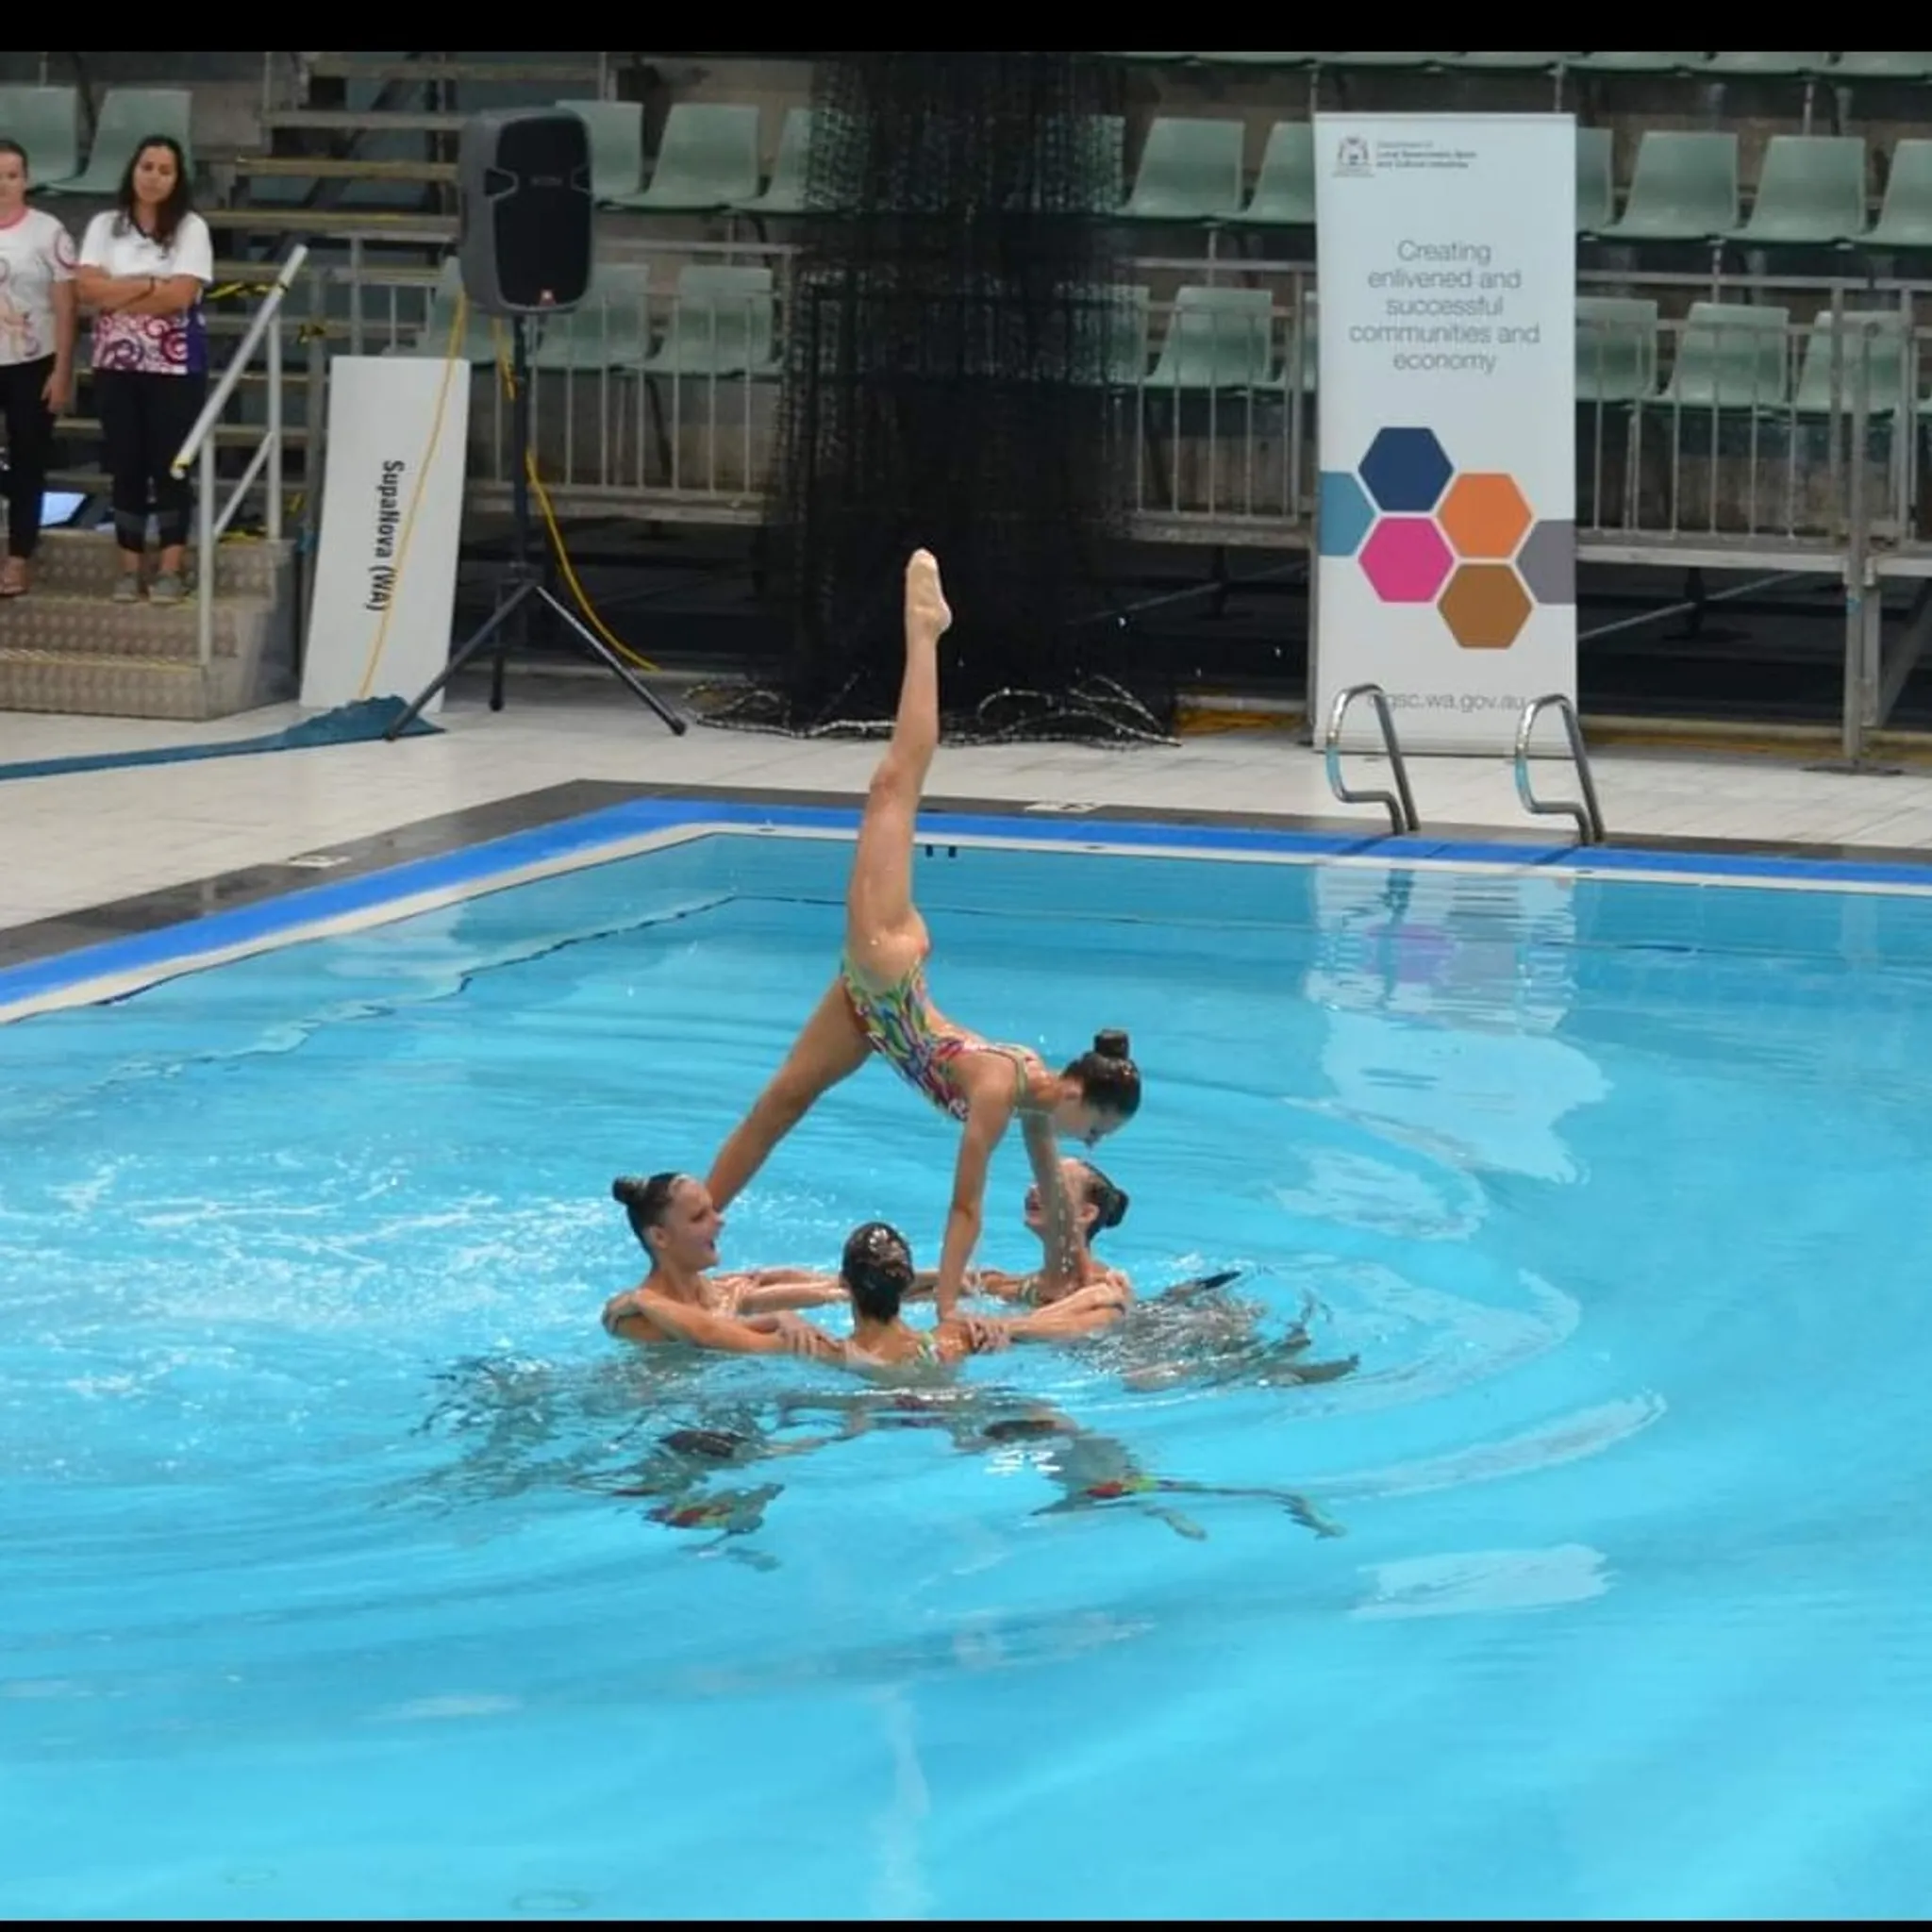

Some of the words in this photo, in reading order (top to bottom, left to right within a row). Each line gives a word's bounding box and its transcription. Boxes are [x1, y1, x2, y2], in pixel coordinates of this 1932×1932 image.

[1397, 240, 1491, 265] Creating
[1368, 269, 1472, 290] enlivened
[1479, 268, 1522, 290] and
[1386, 295, 1504, 316] successful
[1349, 323, 1491, 344] communities
[1498, 322, 1541, 344] and
[1393, 352, 1496, 375] economy
[375, 459, 406, 558] SupaNova
[365, 565, 398, 611] (WA)
